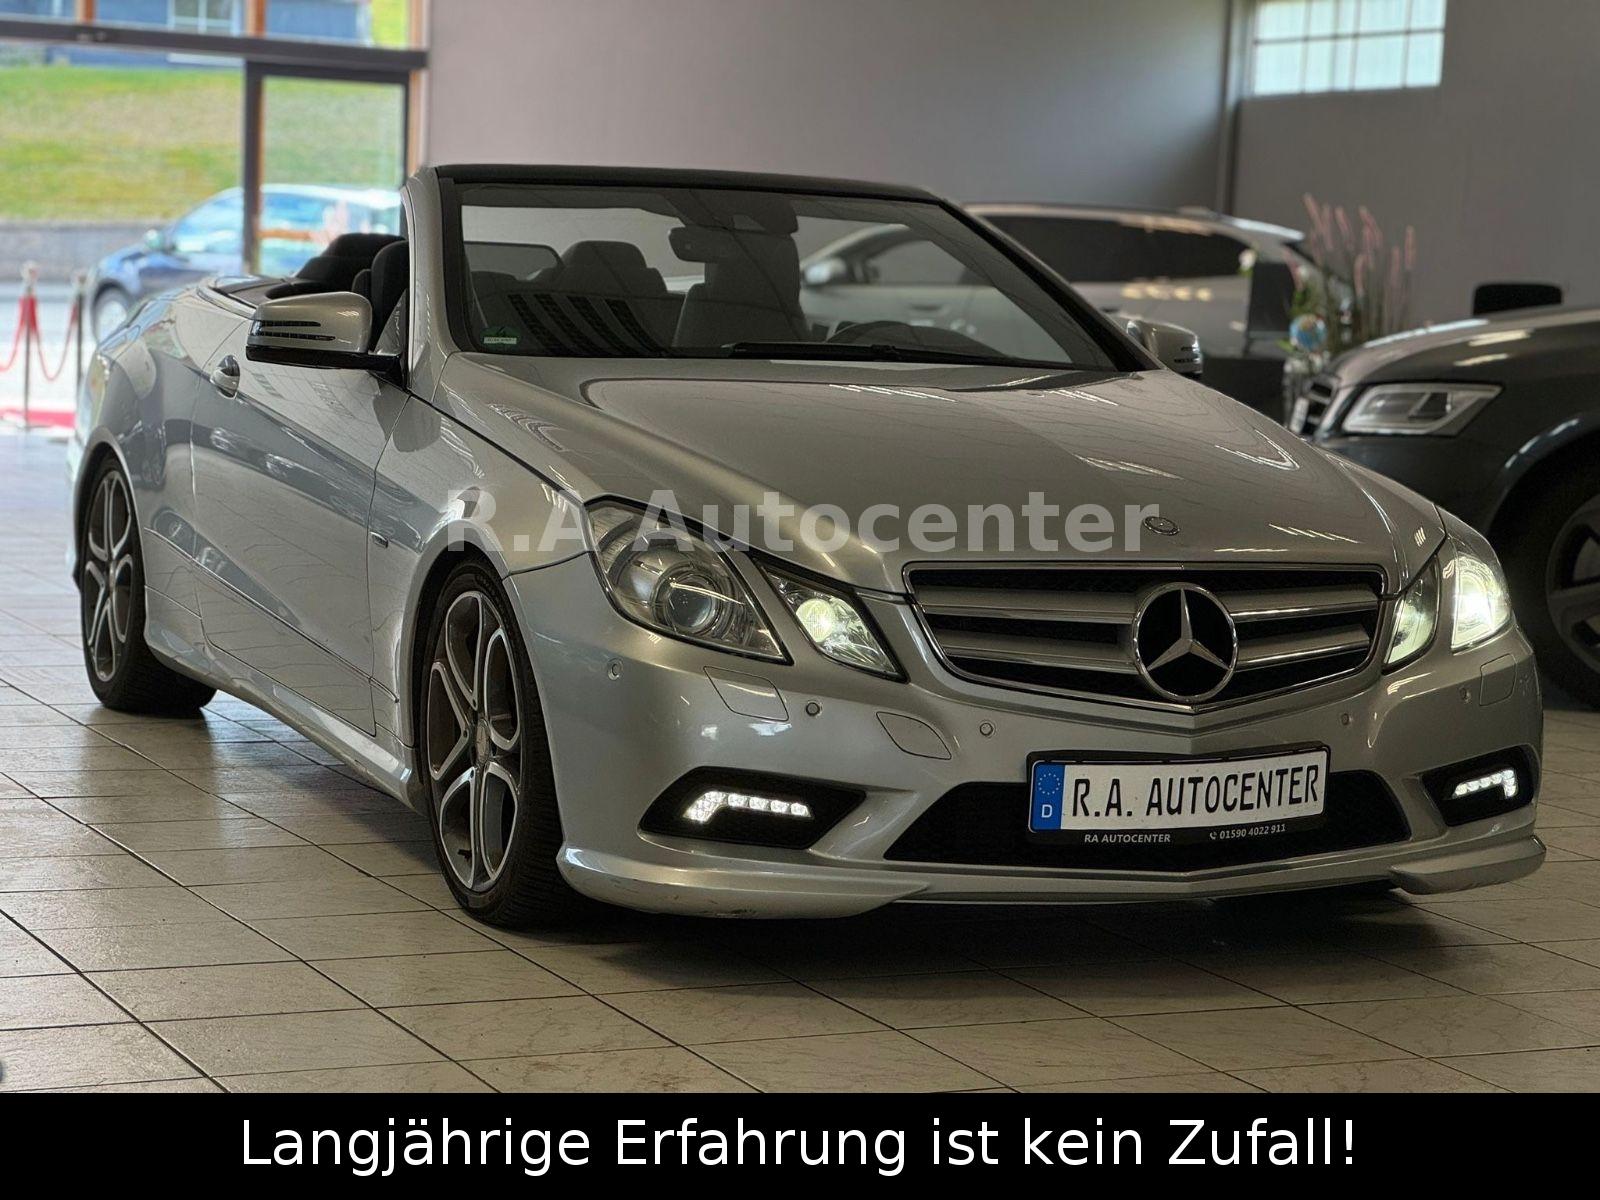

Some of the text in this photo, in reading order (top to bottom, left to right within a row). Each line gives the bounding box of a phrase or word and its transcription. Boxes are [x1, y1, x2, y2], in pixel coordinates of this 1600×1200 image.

[1072, 764, 1319, 817] R.A. AUTOCENTER
[1041, 804, 1053, 818] D
[1084, 834, 1171, 843] RA AUTOCENTER
[1219, 823, 1286, 839] 01590 4022 911
